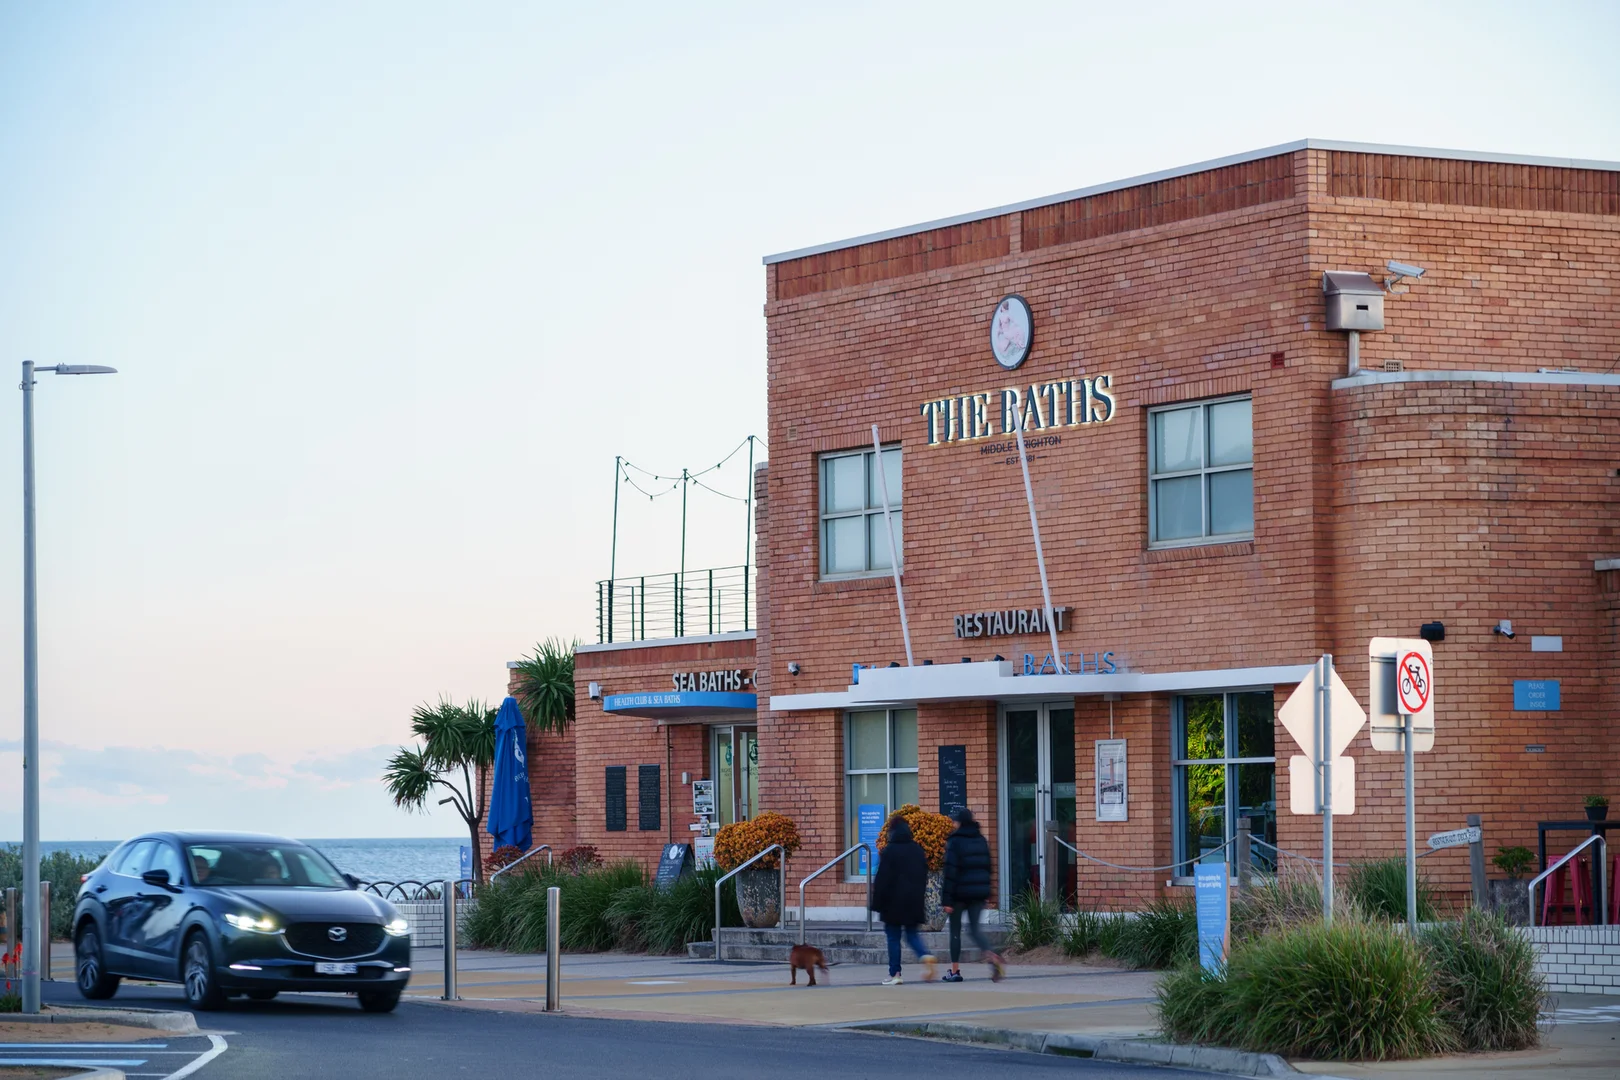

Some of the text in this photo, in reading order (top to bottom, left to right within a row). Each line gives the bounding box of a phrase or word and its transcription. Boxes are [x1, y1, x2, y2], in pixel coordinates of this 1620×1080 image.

[920, 375, 1115, 444] THE BATHS
[980, 441, 1014, 455] MIDDLE
[953, 606, 1066, 638] RESTAURANT
[1023, 651, 1117, 676] BATHS
[672, 672, 696, 692] SEA
[699, 669, 741, 692] BATHS
[1528, 682, 1545, 690] PLEASE
[1528, 691, 1546, 699] ORDER
[1529, 701, 1546, 709] INSIDE
